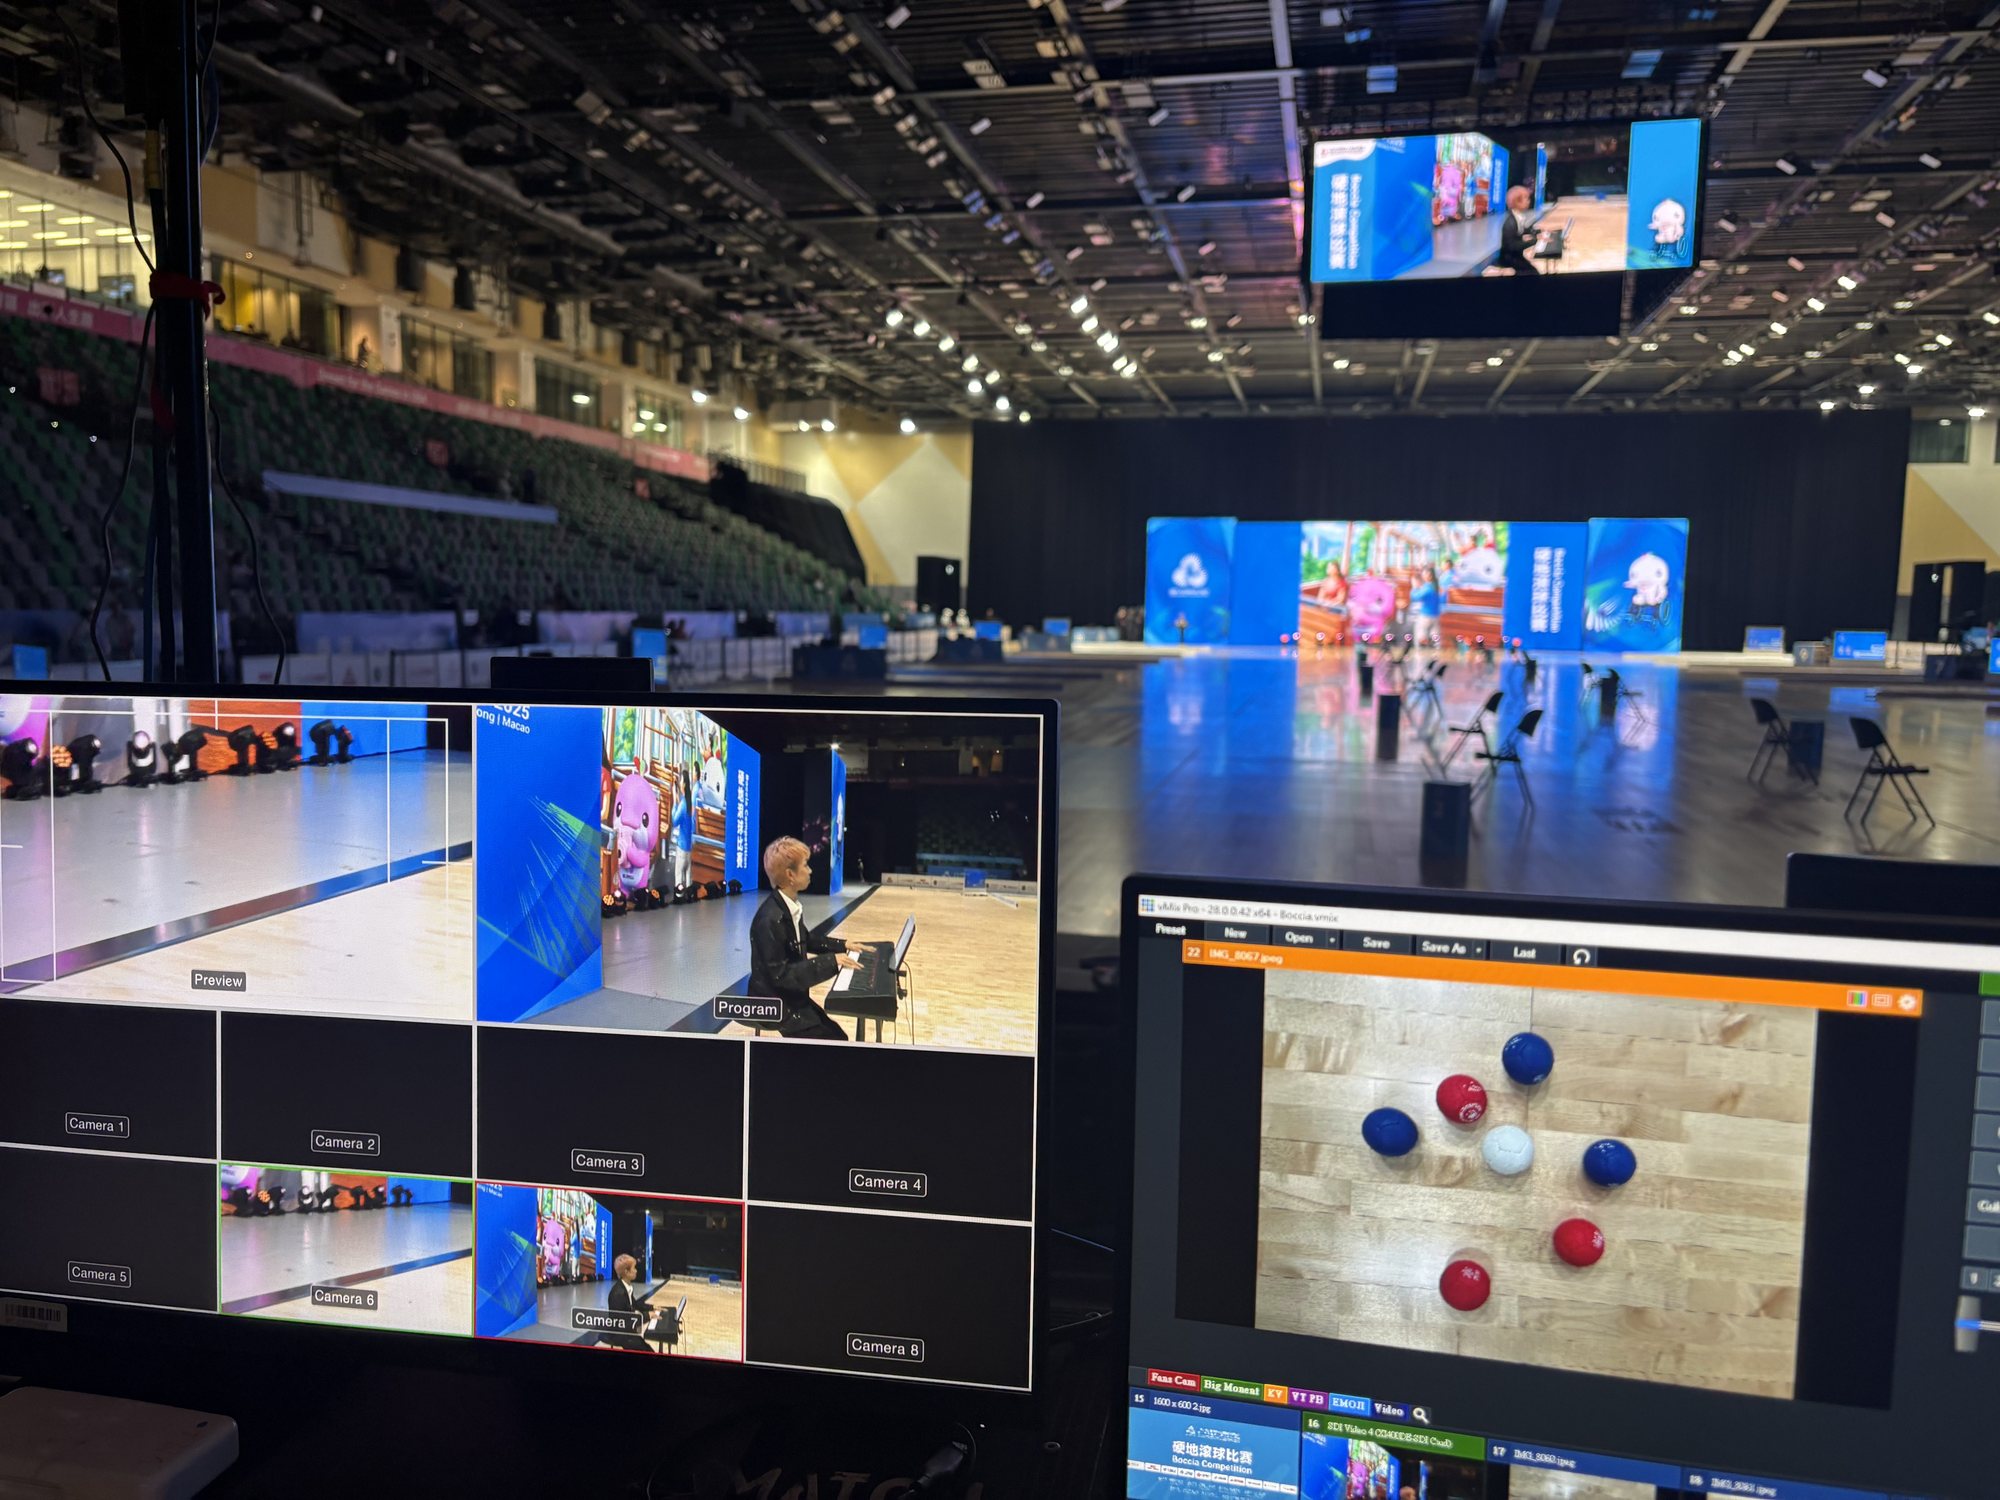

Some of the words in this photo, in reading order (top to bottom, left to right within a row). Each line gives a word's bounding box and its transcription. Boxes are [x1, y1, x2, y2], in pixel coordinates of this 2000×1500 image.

[502, 715, 530, 734] Macao
[1182, 904, 1199, 914] Pro
[1155, 923, 1187, 936] Preset
[1224, 927, 1248, 939] New
[1285, 932, 1314, 945] Open
[1362, 936, 1391, 949] Save
[1186, 947, 1200, 958] 22
[1422, 941, 1450, 953] Save
[1451, 942, 1467, 954] As
[1513, 946, 1536, 959] Last
[194, 973, 243, 989] Preview
[718, 1001, 778, 1018] Program
[69, 1117, 114, 1133] Camera
[118, 1121, 124, 1134] 1
[315, 1135, 364, 1150] Camera
[367, 1138, 376, 1152] 2
[575, 1154, 627, 1170] Camera
[631, 1158, 640, 1172] 3
[853, 1174, 908, 1191] Camera
[913, 1178, 922, 1192] 4
[71, 1266, 117, 1281] Camera
[119, 1270, 127, 1283] 5
[314, 1289, 363, 1305] Camera
[367, 1292, 375, 1306] 6
[575, 1312, 626, 1329] Camera
[630, 1317, 638, 1330] 7
[851, 1338, 906, 1356] Camera
[910, 1342, 919, 1357] 8
[1151, 1372, 1174, 1385] Fans
[1175, 1376, 1196, 1388] Cam
[1203, 1379, 1221, 1392] Big
[1134, 1393, 1145, 1403] 15
[1153, 1396, 1171, 1407] 1600
[1178, 1400, 1192, 1410] 600
[1268, 1388, 1283, 1399] KV
[1291, 1392, 1307, 1402] VT
[1374, 1402, 1405, 1416] Video
[1308, 1418, 1320, 1428] 16
[1327, 1421, 1343, 1432] SDI
[1344, 1424, 1367, 1436] Video
[1368, 1427, 1374, 1436] 4
[1172, 1454, 1200, 1467] Boccia
[1201, 1459, 1253, 1475] Competition
